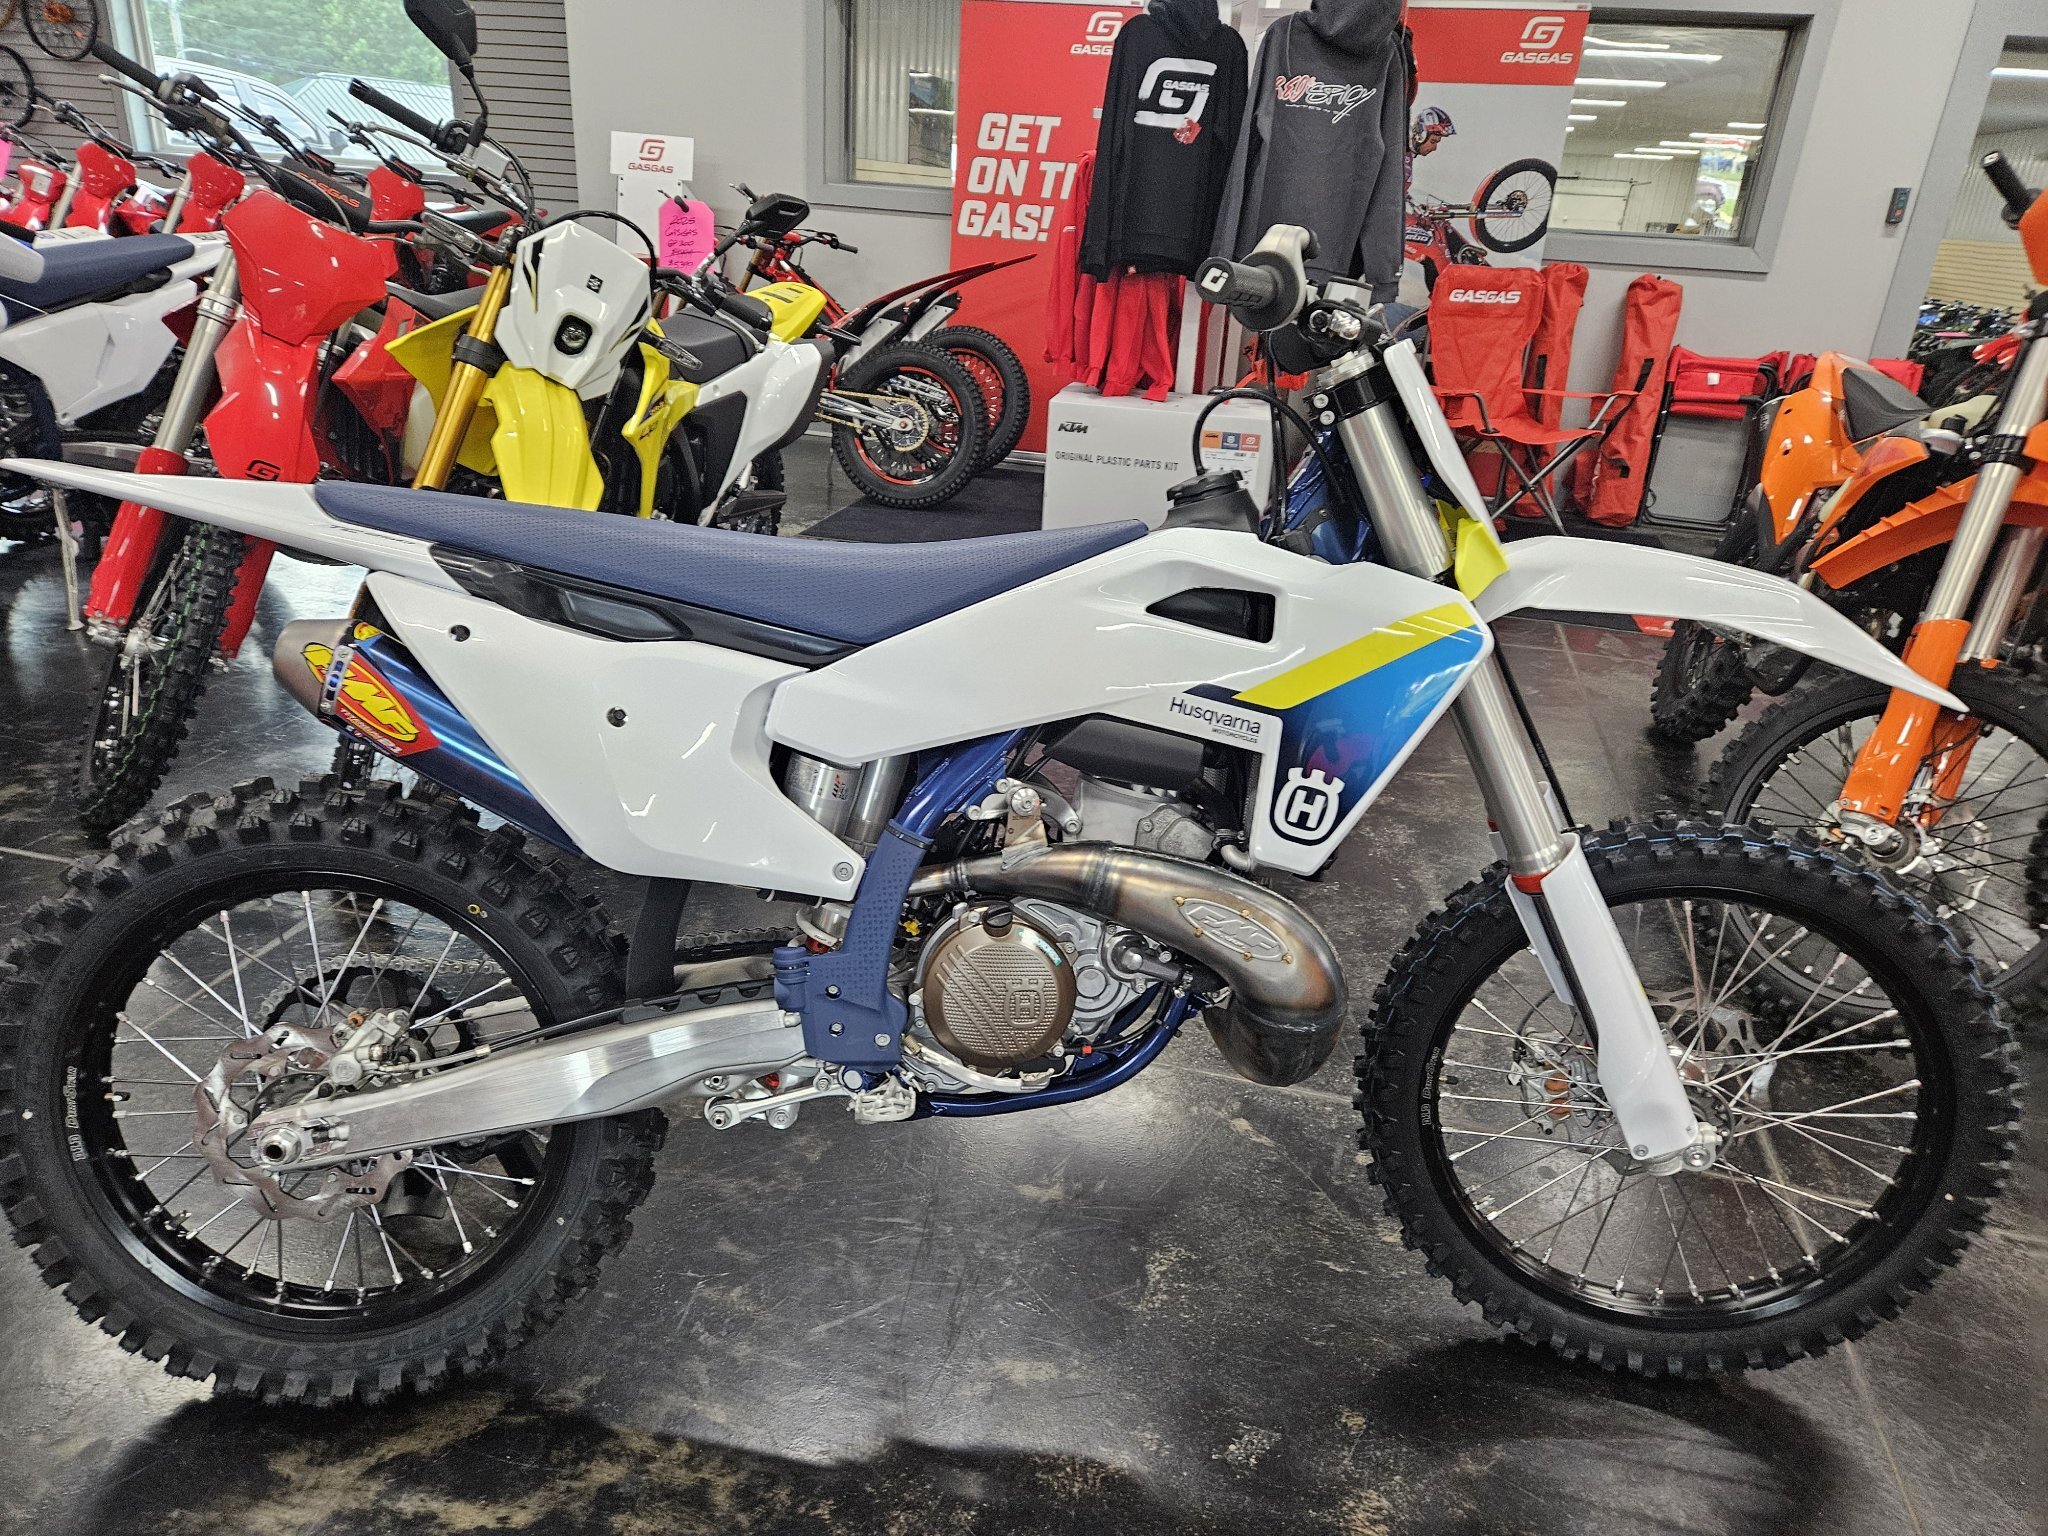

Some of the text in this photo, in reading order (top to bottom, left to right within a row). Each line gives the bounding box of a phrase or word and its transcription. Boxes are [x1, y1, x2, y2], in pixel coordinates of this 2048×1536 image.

[1070, 43, 1114, 56] GASG
[1500, 51, 1574, 64] GASGAS
[1162, 79, 1210, 92] GASGAS
[977, 112, 1062, 154] GET
[627, 162, 674, 174] GASGAS
[967, 156, 1030, 197] ON
[957, 199, 1055, 242] GAS!
[1448, 288, 1522, 304] GASGAS
[1057, 421, 1089, 435] KTM
[1054, 450, 1179, 472] ORIGINAL PLASTIC PARTS KIT
[1169, 696, 1262, 735] Husqvarna
[1186, 905, 1281, 950] FMF
